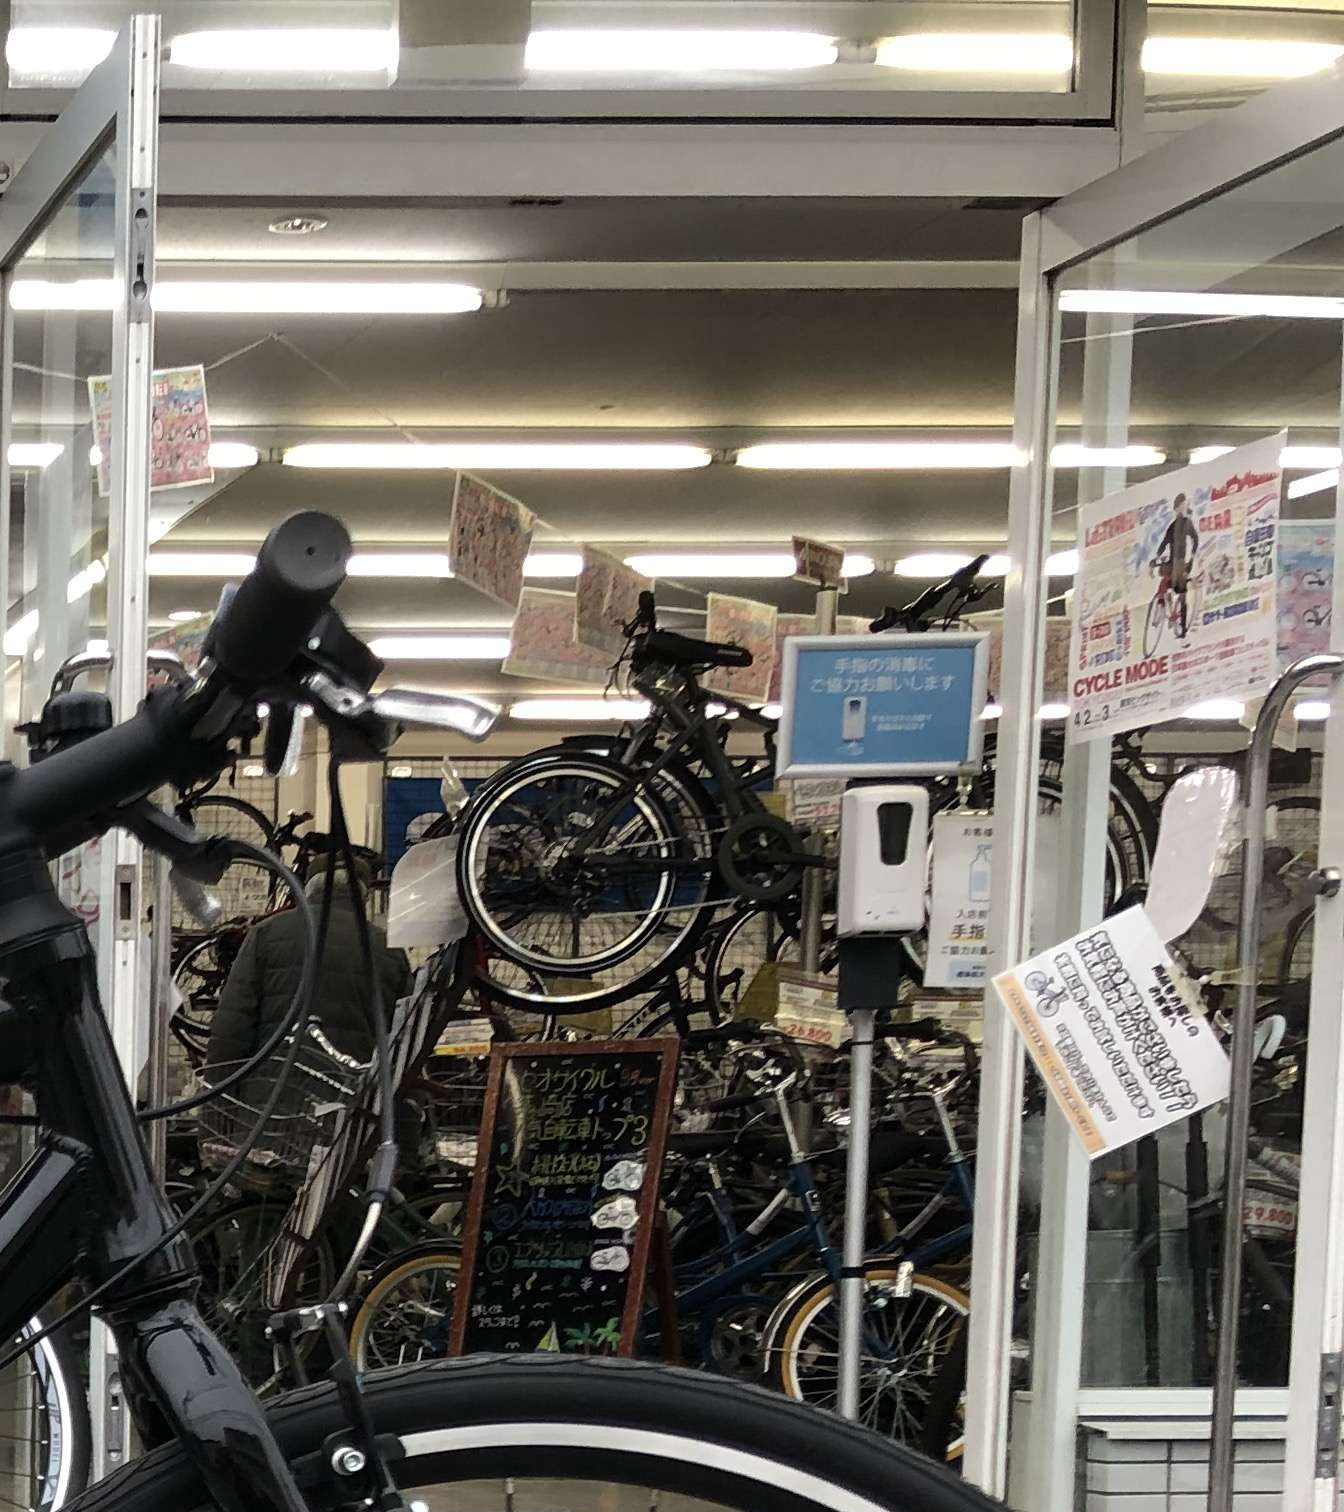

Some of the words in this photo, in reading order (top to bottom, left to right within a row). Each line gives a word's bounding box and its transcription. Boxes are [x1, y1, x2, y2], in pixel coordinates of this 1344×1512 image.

[811, 675, 955, 693] ご協力お願いします
[1073, 668, 1122, 698] CYCLE
[1125, 655, 1169, 684] MODE
